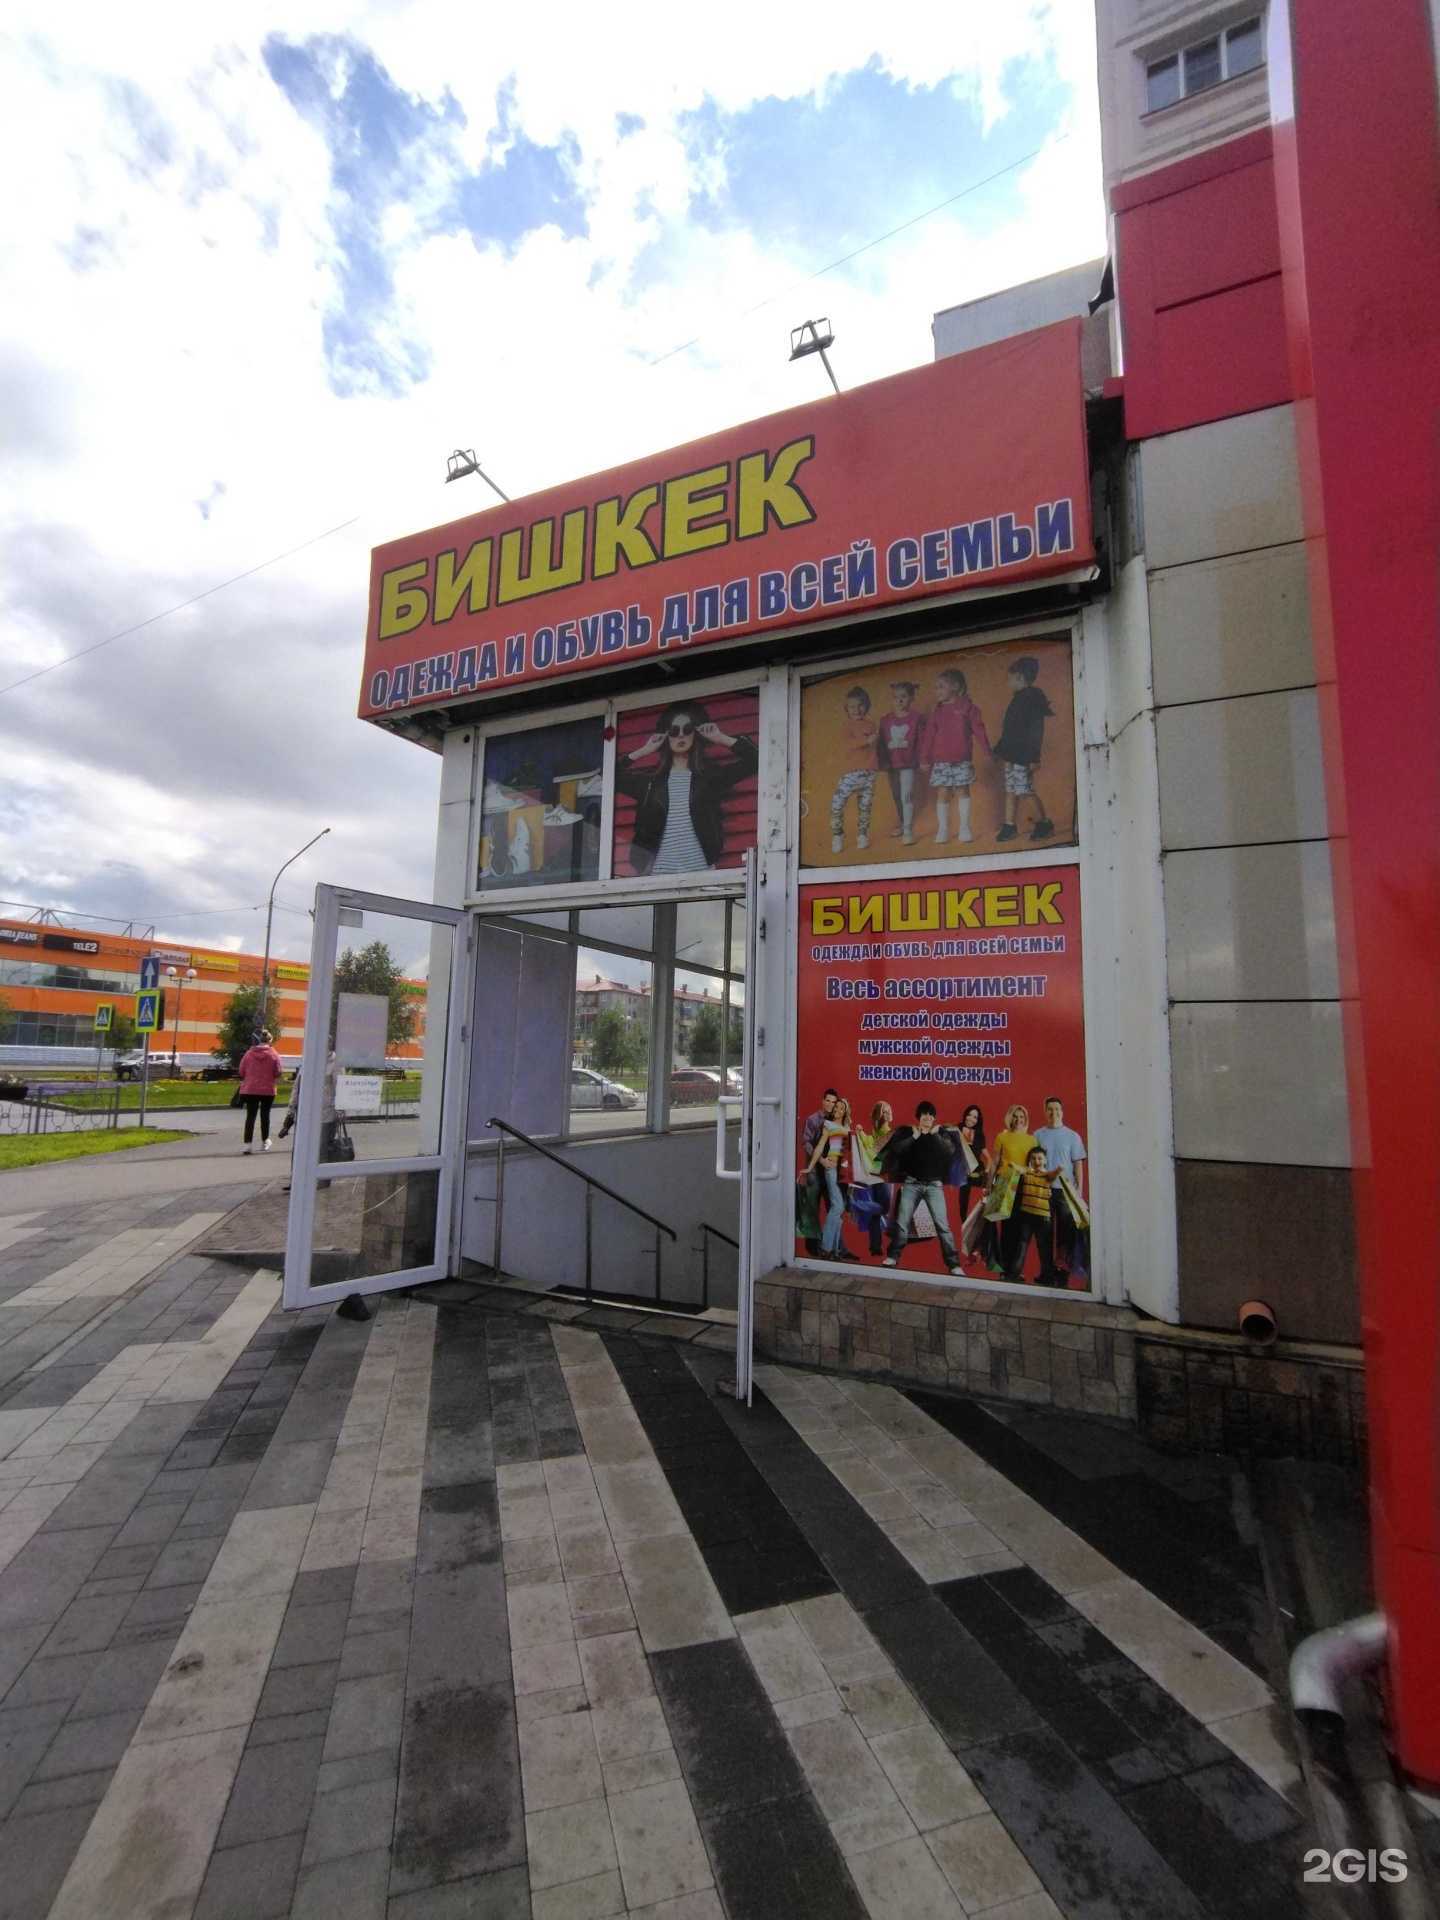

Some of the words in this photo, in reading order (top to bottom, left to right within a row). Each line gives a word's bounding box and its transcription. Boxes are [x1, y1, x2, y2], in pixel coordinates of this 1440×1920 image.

[378, 435, 817, 641] БИШКЕК
[369, 641, 498, 708] ОДЕЖДА
[504, 633, 526, 677] И
[532, 604, 652, 670] ОБУВЬ
[658, 577, 749, 648] ДЛЯ
[758, 539, 877, 621] ВСЕЙ
[886, 498, 1074, 591] СЕМЬИ
[811, 881, 1065, 936] БИШКЕК
[73, 942, 98, 953] TELE2
[812, 944, 871, 963] ОДЕЖДА
[871, 943, 882, 959] И
[884, 941, 931, 959] ОБУВЬ
[932, 939, 966, 959] ДЛЯ
[967, 935, 1008, 956] ВСЕЙ
[1009, 935, 1066, 954] СЕМЬИ
[826, 976, 881, 1001] Весь
[884, 975, 1048, 1002] ассортимент
[861, 1010, 929, 1030] детской
[931, 1012, 1008, 1031] одежды
[858, 1036, 932, 1056] мужской
[934, 1039, 1012, 1058] одежды
[859, 1063, 931, 1082] женской
[934, 1066, 1011, 1086] одежды
